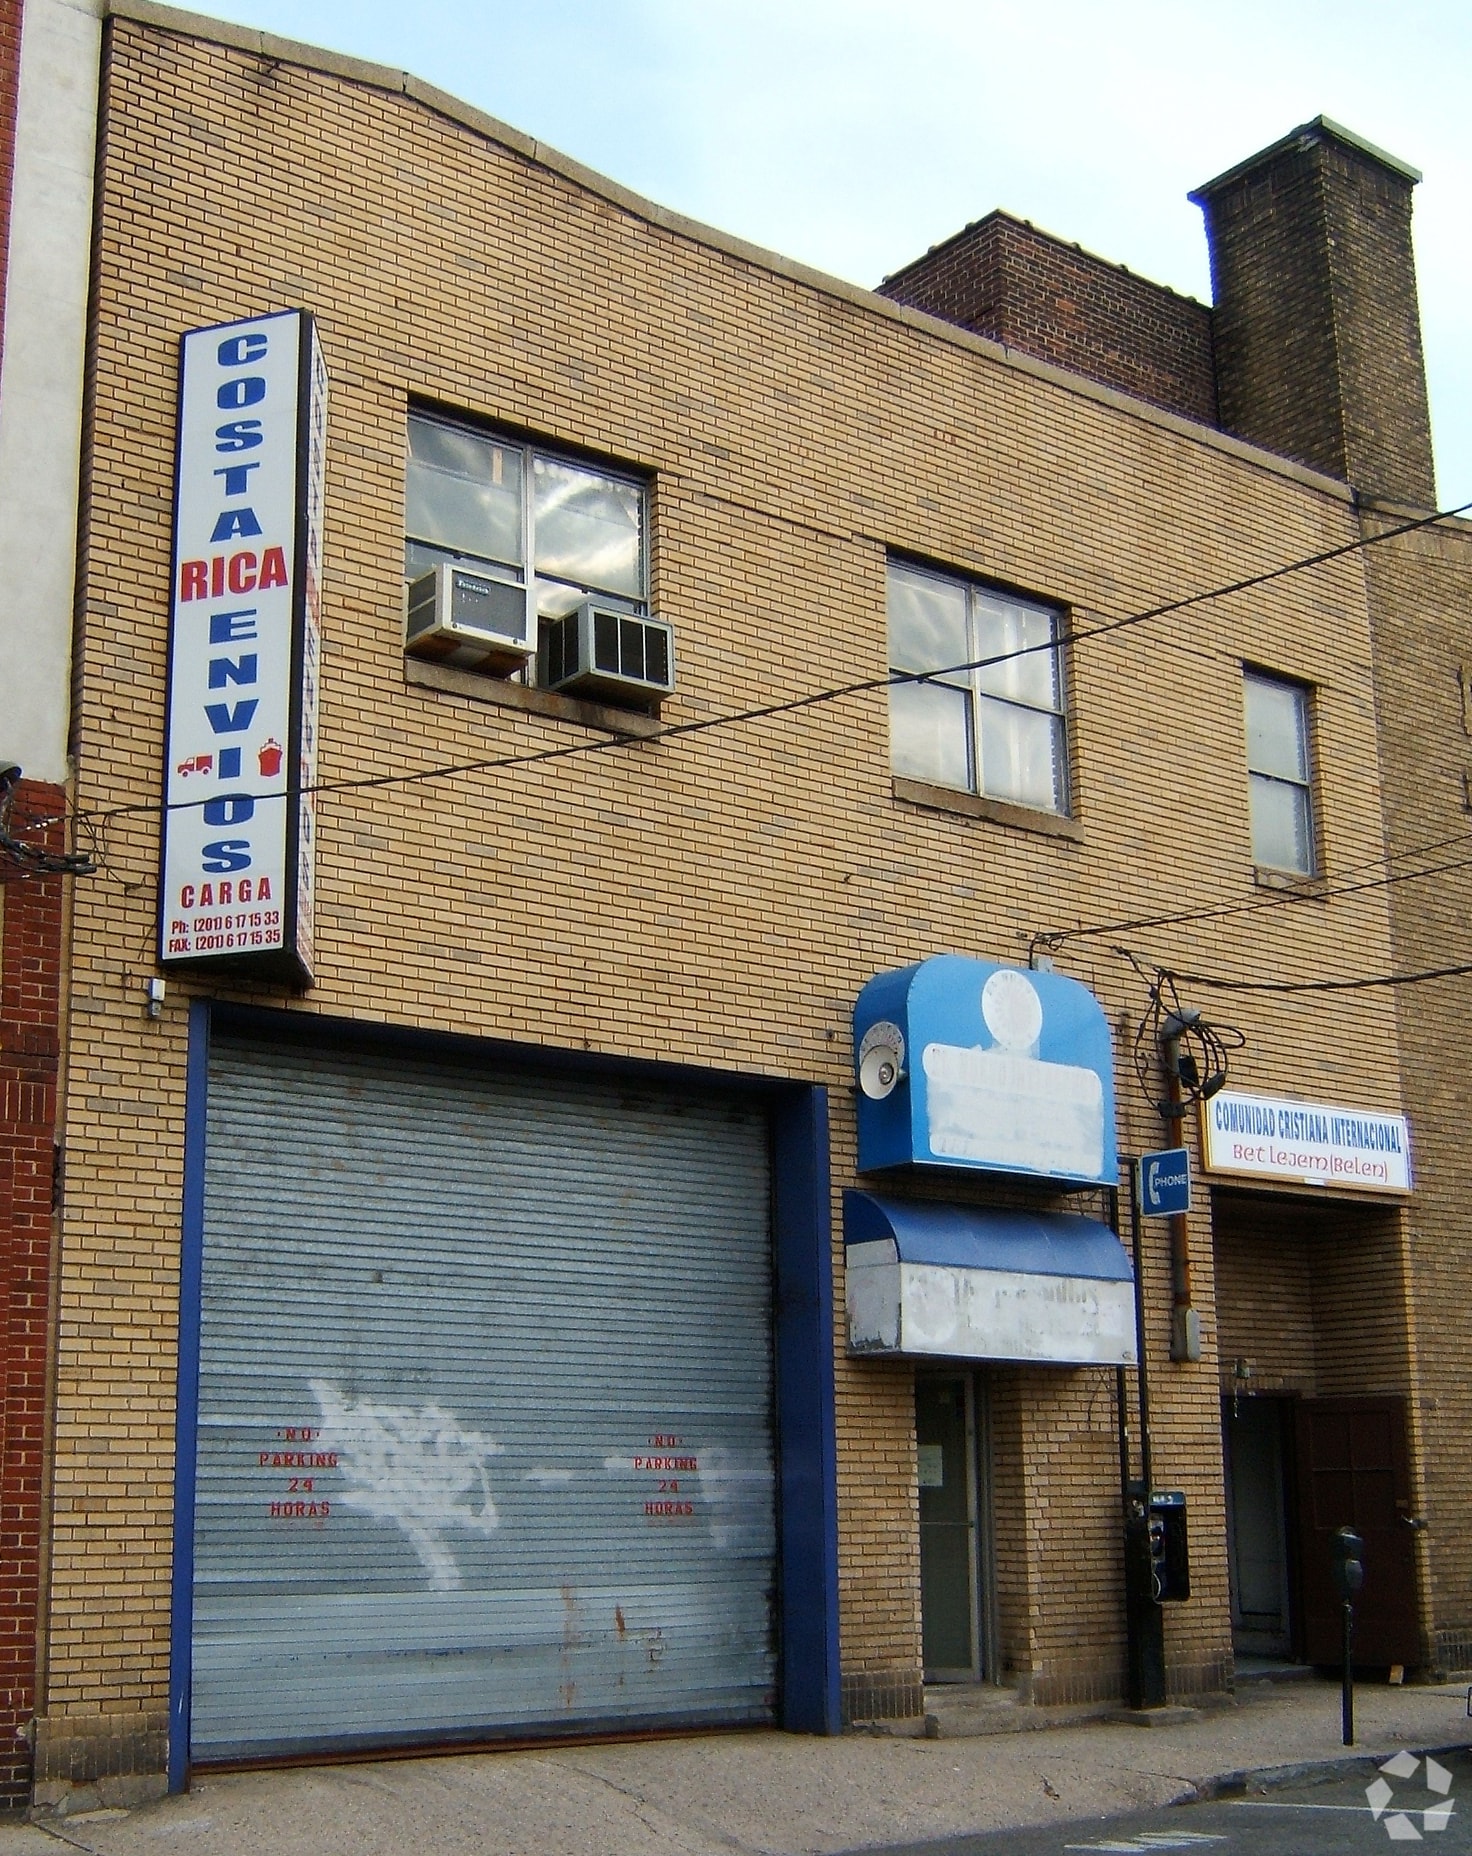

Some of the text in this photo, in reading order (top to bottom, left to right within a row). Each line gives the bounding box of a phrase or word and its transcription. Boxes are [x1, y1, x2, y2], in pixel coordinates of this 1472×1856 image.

[210, 334, 268, 543] COSTA
[181, 547, 289, 602] RICA
[202, 609, 259, 873] ENVIOS
[181, 877, 271, 908] CARGA
[172, 921, 189, 934] Ph:
[194, 916, 222, 932] (201)
[169, 938, 191, 952] FAX:
[196, 935, 223, 950] (201)
[1216, 1101, 1402, 1154] COMUNIDAD CRISTIANA INTERNACIONAL
[1233, 1144, 1265, 1162] Bet
[1154, 1173, 1187, 1187] PHONE
[260, 1451, 337, 1467] PARKING
[634, 1456, 697, 1470] PARKING
[271, 1501, 330, 1517] HORAS
[644, 1501, 693, 1516] HORAS
